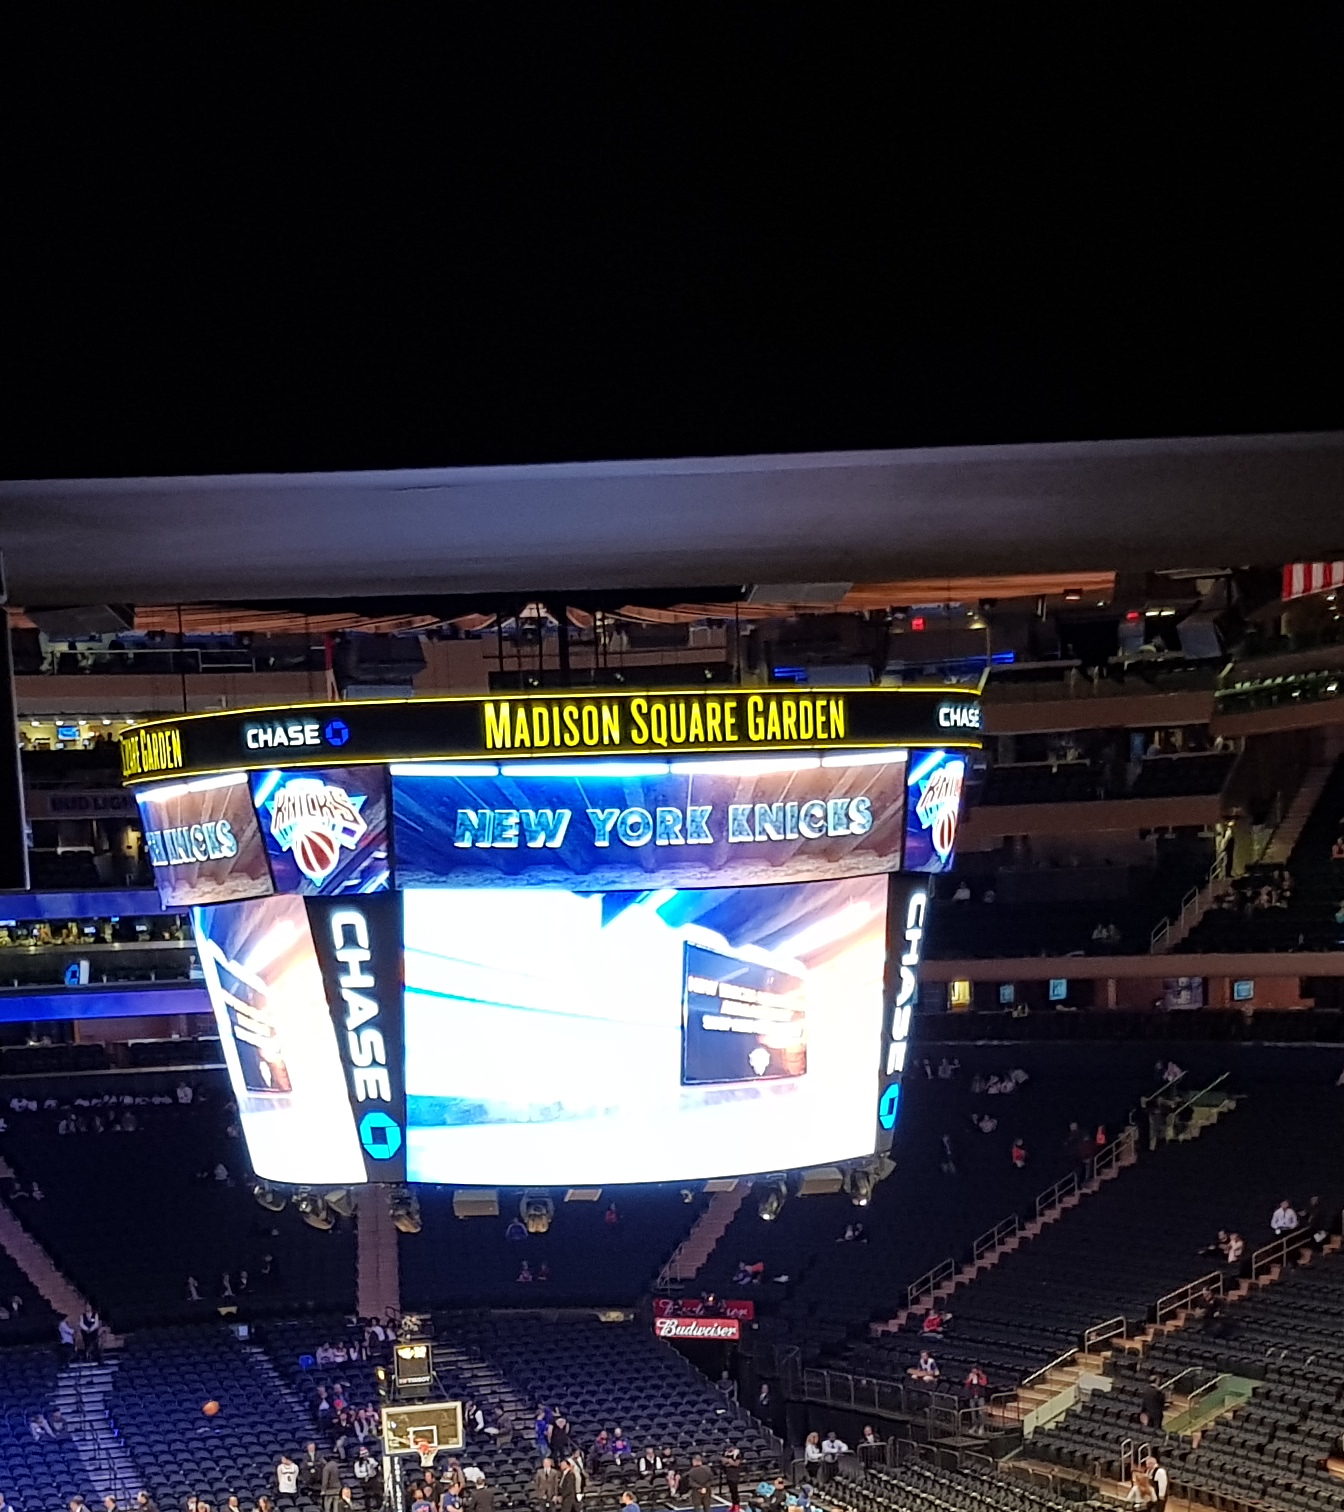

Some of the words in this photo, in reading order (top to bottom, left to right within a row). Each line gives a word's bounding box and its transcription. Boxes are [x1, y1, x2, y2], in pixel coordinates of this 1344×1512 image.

[246, 724, 321, 749] CHASE
[484, 701, 621, 749] MADISON
[630, 698, 739, 747] SQUARE
[747, 695, 846, 742] GARDEN
[939, 706, 980, 728] CHASE
[140, 729, 183, 772] GARDEN
[272, 788, 366, 829] KNICKS
[454, 808, 571, 848] NEW
[585, 805, 715, 847] YORK
[728, 797, 873, 843] KNICKS
[163, 820, 237, 865] KNICKS
[886, 893, 927, 1075] CHASE
[331, 911, 392, 1103] CHASE
[656, 1318, 736, 1336] Budweiser
